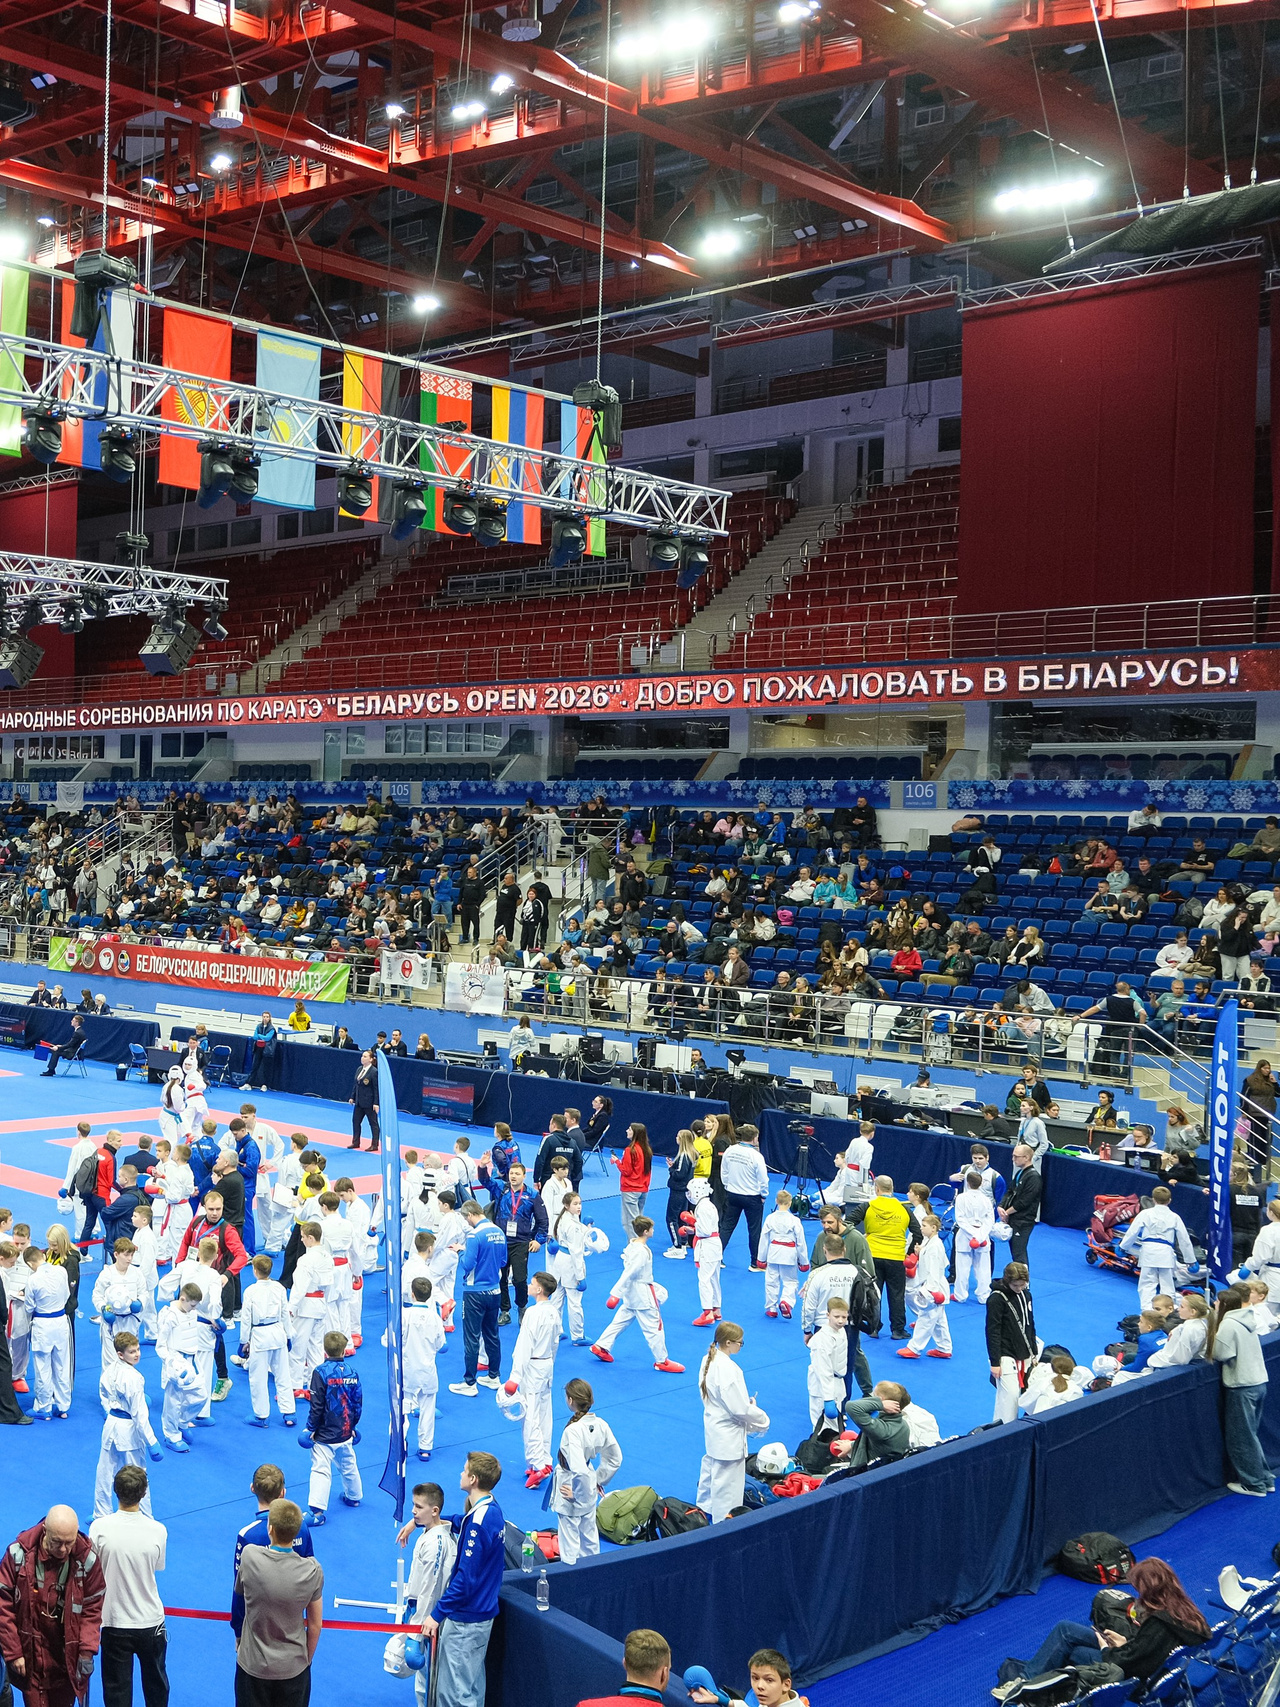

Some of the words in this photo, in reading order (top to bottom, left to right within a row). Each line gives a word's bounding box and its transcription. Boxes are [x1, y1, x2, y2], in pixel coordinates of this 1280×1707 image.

[80, 703, 213, 726] СОРЕВНОВАНИЯ
[218, 702, 243, 721] ПО
[248, 698, 322, 720] КАРАТЭ
[327, 692, 458, 716] "БЕЛАРУСЬ
[466, 688, 536, 713] OPEN
[634, 678, 735, 710] ДОБРО
[743, 669, 974, 702] ПОЖАЛОВАТЬ
[984, 667, 1007, 693] В
[1018, 656, 1239, 691] БЕЛАРУСЬ!
[17, 785, 29, 794] 104
[391, 784, 409, 796] 105
[905, 783, 934, 798] 106
[136, 954, 207, 979] БЕЛОРУССКАЯ
[209, 962, 274, 987] ФЕДЕРАЦИЯ
[278, 968, 322, 991] КАРАТЭ
